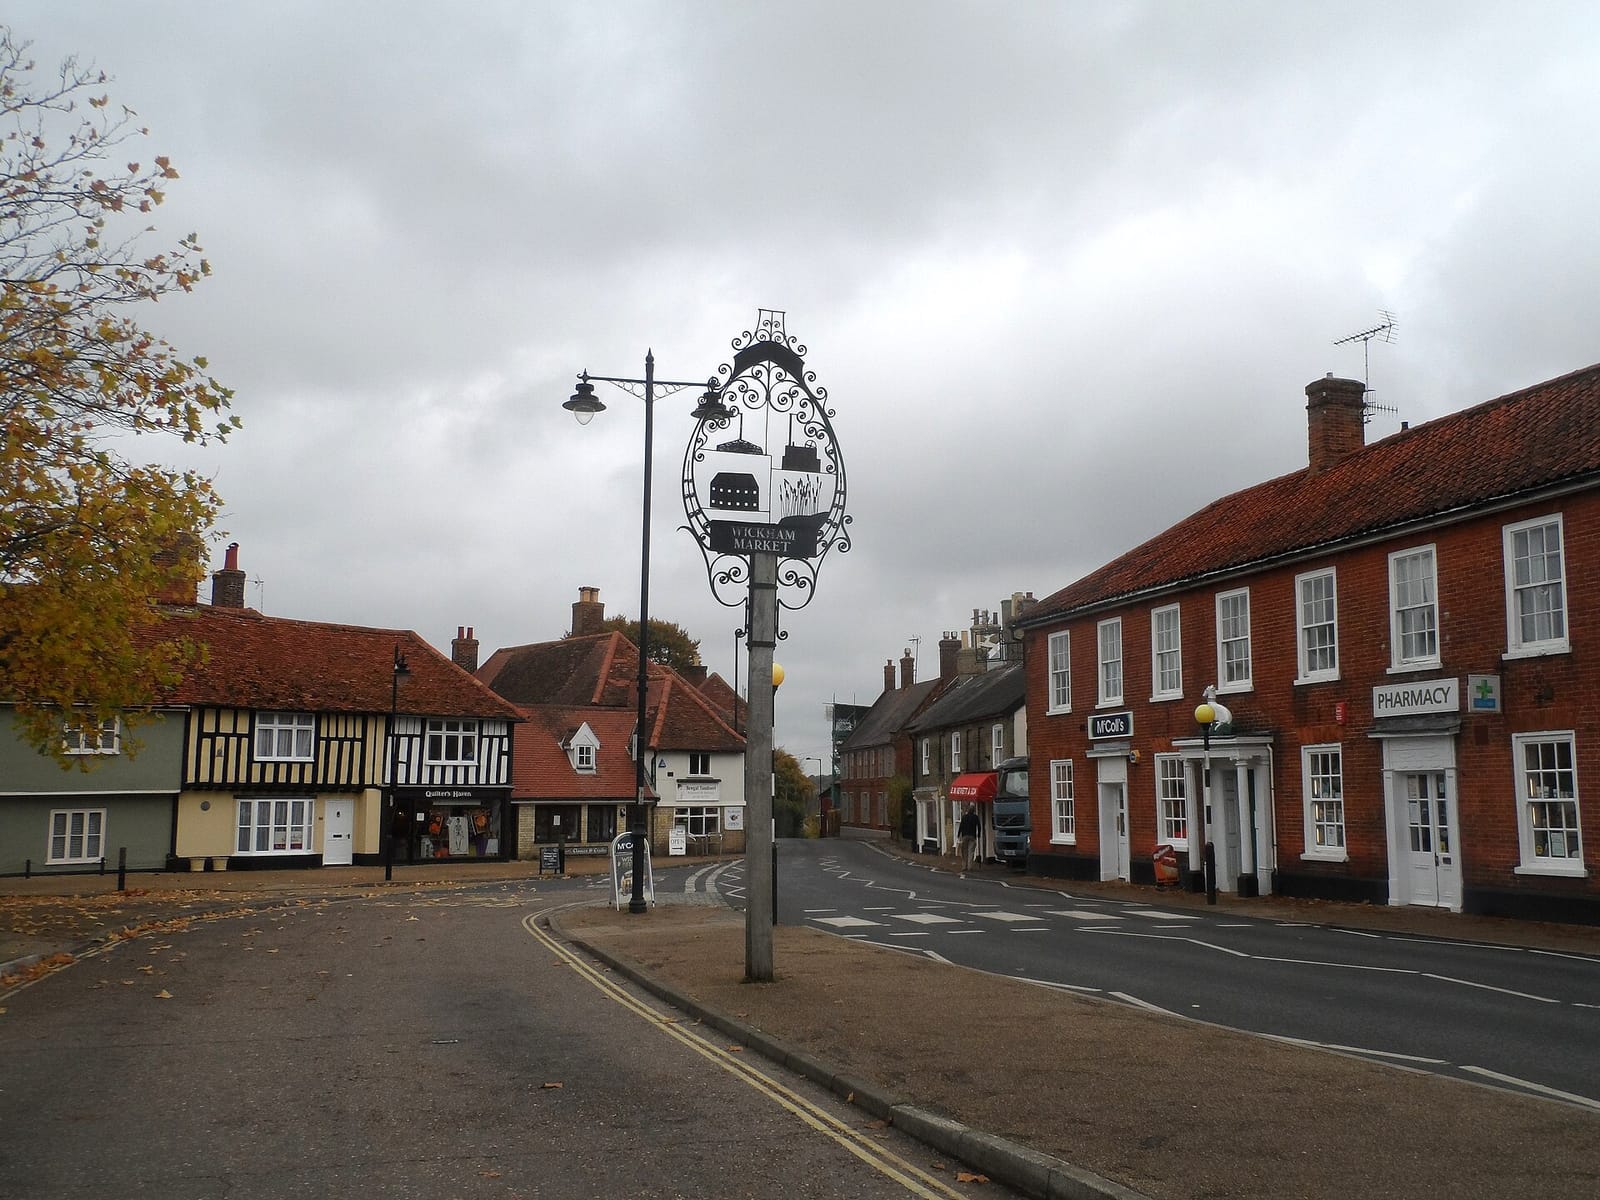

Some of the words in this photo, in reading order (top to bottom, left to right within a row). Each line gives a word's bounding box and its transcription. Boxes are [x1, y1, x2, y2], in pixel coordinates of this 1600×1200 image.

[732, 527, 796, 541] WICKHAM
[734, 538, 791, 552] MARKET
[1378, 686, 1451, 709] PHARMACY
[453, 790, 472, 798] Haven
